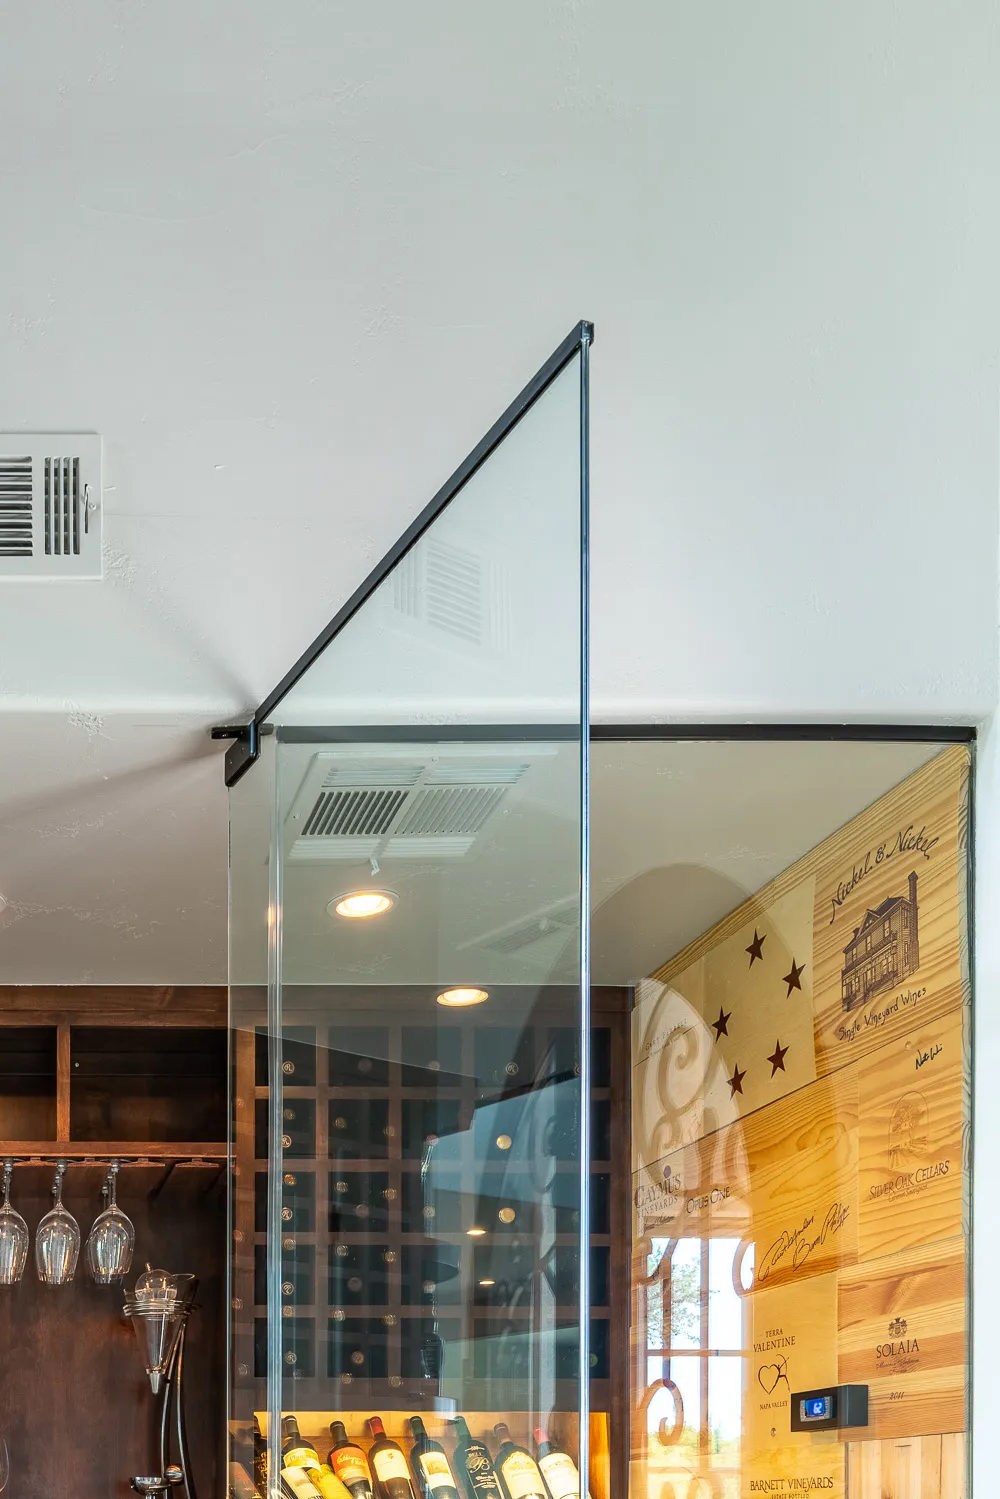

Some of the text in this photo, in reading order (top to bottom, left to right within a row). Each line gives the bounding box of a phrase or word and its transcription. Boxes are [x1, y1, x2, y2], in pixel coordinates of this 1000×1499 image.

[829, 851, 873, 925] Nickel
[886, 825, 940, 860] Nickel
[838, 986, 927, 1043] Single Vineyard Wines
[869, 1160, 950, 1201] SILVER OAK CELLARS
[709, 1186, 731, 1204] ONE
[765, 1328, 784, 1339] TERRA
[753, 1335, 796, 1353] VALENTINE
[876, 1338, 920, 1359] SOLAIA
[760, 1400, 789, 1410] NAPA VALLEY
[750, 1476, 834, 1494] BARNETT VINEYARDS
